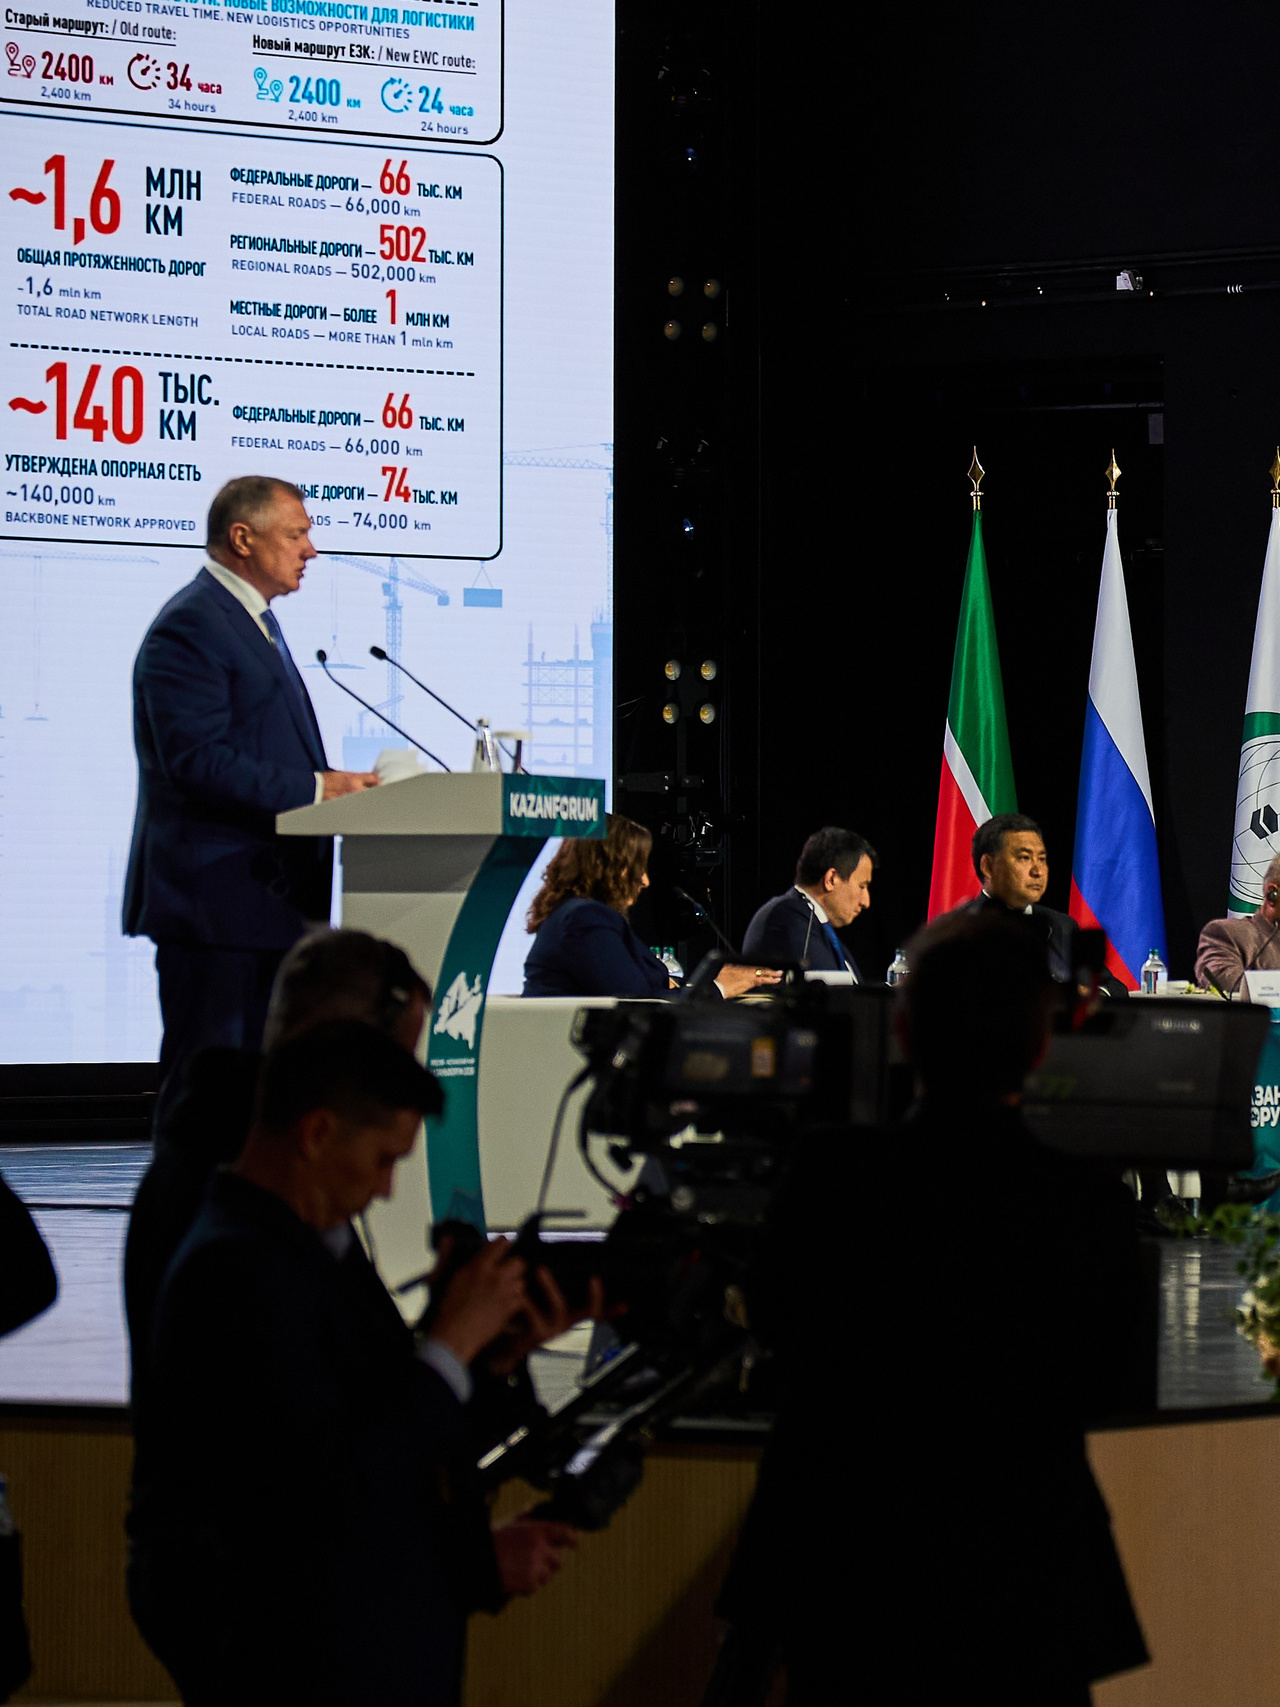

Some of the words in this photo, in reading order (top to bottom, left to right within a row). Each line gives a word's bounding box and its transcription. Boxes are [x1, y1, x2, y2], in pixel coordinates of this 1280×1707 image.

[5, 9, 49, 27] Старый
[53, 18, 109, 35] маршрут:
[120, 21, 139, 36] Old
[142, 24, 176, 40] route:
[87, 0, 141, 12] REDUCED
[146, 3, 189, 17] TRAVEL
[192, 8, 223, 21] TIME.
[227, 11, 253, 24] NEW
[257, 15, 316, 30] LOGISTICS
[319, 20, 410, 39] OPPORTUNITIES
[271, 0, 368, 19] ВОЗМОЖНОСТИ
[371, 7, 398, 25] ДЛЯ
[402, 10, 475, 30] ЛОГИСТИКИ
[252, 35, 291, 51] Новый
[294, 41, 346, 60] маршрут
[386, 48, 410, 63] New
[413, 50, 438, 66] EWC
[442, 54, 475, 68] route:
[41, 51, 94, 84] 2400
[99, 75, 114, 86] км
[166, 62, 192, 91] 34
[198, 82, 222, 94] часа
[41, 86, 71, 100] 2,400
[74, 90, 91, 101] km
[168, 99, 181, 110] 34
[184, 100, 216, 113] hours
[288, 75, 341, 106] 2400
[347, 98, 361, 109] км
[418, 86, 444, 114] 24
[449, 104, 474, 117] часа
[288, 110, 318, 123] 2,400
[321, 113, 338, 124] km
[421, 122, 434, 132] 24
[437, 123, 468, 135] hours
[146, 166, 201, 201] МЛН
[230, 168, 313, 188] ФЕДЕРАЛЬНЫЕ
[315, 177, 358, 192] ДОРОГИ
[380, 159, 411, 195] 66
[417, 183, 443, 199] ТЫС.
[445, 185, 462, 200] КМ
[8, 154, 121, 245] ~1,6
[232, 192, 284, 206] FEDERAL
[288, 197, 326, 210] ROADS
[345, 197, 400, 216] 66,000
[404, 206, 421, 217] km
[146, 203, 183, 237] КМ
[230, 234, 317, 255] РЕГИОНАЛЬНЫЕ
[319, 242, 362, 258] ДОРОГИ
[380, 224, 426, 263] 502
[428, 249, 455, 264] ТЫС.
[456, 251, 474, 266] КМ
[17, 248, 60, 267] ОБЩАЯ
[64, 251, 165, 273] ПРОТЯЖЕННОСТЬ
[168, 260, 206, 277] ДОРОГ
[232, 259, 290, 274] REGIONAL
[294, 264, 332, 277] ROADS
[351, 264, 416, 282] 502,000
[419, 273, 436, 284] km
[59, 288, 81, 298] mln
[84, 289, 101, 300] km
[230, 300, 281, 317] МЕСТНЫЕ
[284, 304, 327, 320] ДОРОГИ
[343, 308, 377, 324] БОЛЕЕ
[385, 289, 396, 325] 1
[406, 312, 430, 327] МЛН
[432, 313, 450, 328] КМ
[17, 304, 51, 317] TOTAL
[55, 307, 87, 320] ROAD
[90, 310, 149, 324] NETWORK
[152, 314, 198, 327] LENGTH
[232, 325, 268, 338] LOCAL
[271, 327, 310, 340] ROADS
[329, 331, 362, 344] MORE
[364, 333, 396, 345] THAN
[400, 331, 406, 346] 1
[411, 337, 432, 348] mln
[436, 338, 453, 349] km
[8, 362, 144, 445] ~140
[158, 371, 219, 406] ТЫС.
[159, 409, 197, 441] КМ
[232, 405, 316, 424] ФЕДЕРАЛЬНЫЕ
[318, 410, 361, 427] ДОРОГИ
[382, 393, 413, 429] 66
[419, 416, 445, 431] ТЫС.
[447, 418, 464, 432] КМ
[231, 436, 284, 450] FEDERAL
[288, 440, 326, 452] ROADS
[345, 438, 400, 456] 66,000
[406, 446, 423, 457] km
[5, 453, 98, 477] УТВЕРЖДЕНА
[101, 459, 165, 480] ОПОРНАЯ
[168, 463, 201, 481] СЕТЬ
[6, 483, 94, 506] ~140,000
[98, 495, 116, 506] km
[321, 485, 364, 502] ДОРОГИ
[381, 466, 411, 503] 74
[412, 489, 438, 504] ТЫС.
[440, 491, 458, 505] КМ
[5, 511, 69, 525] BACKBONE
[72, 515, 131, 528] NETWORK
[134, 518, 196, 532] APPROVED
[353, 512, 407, 530] 74,000
[414, 520, 431, 531] km
[510, 792, 598, 821] KAZANFORUM
